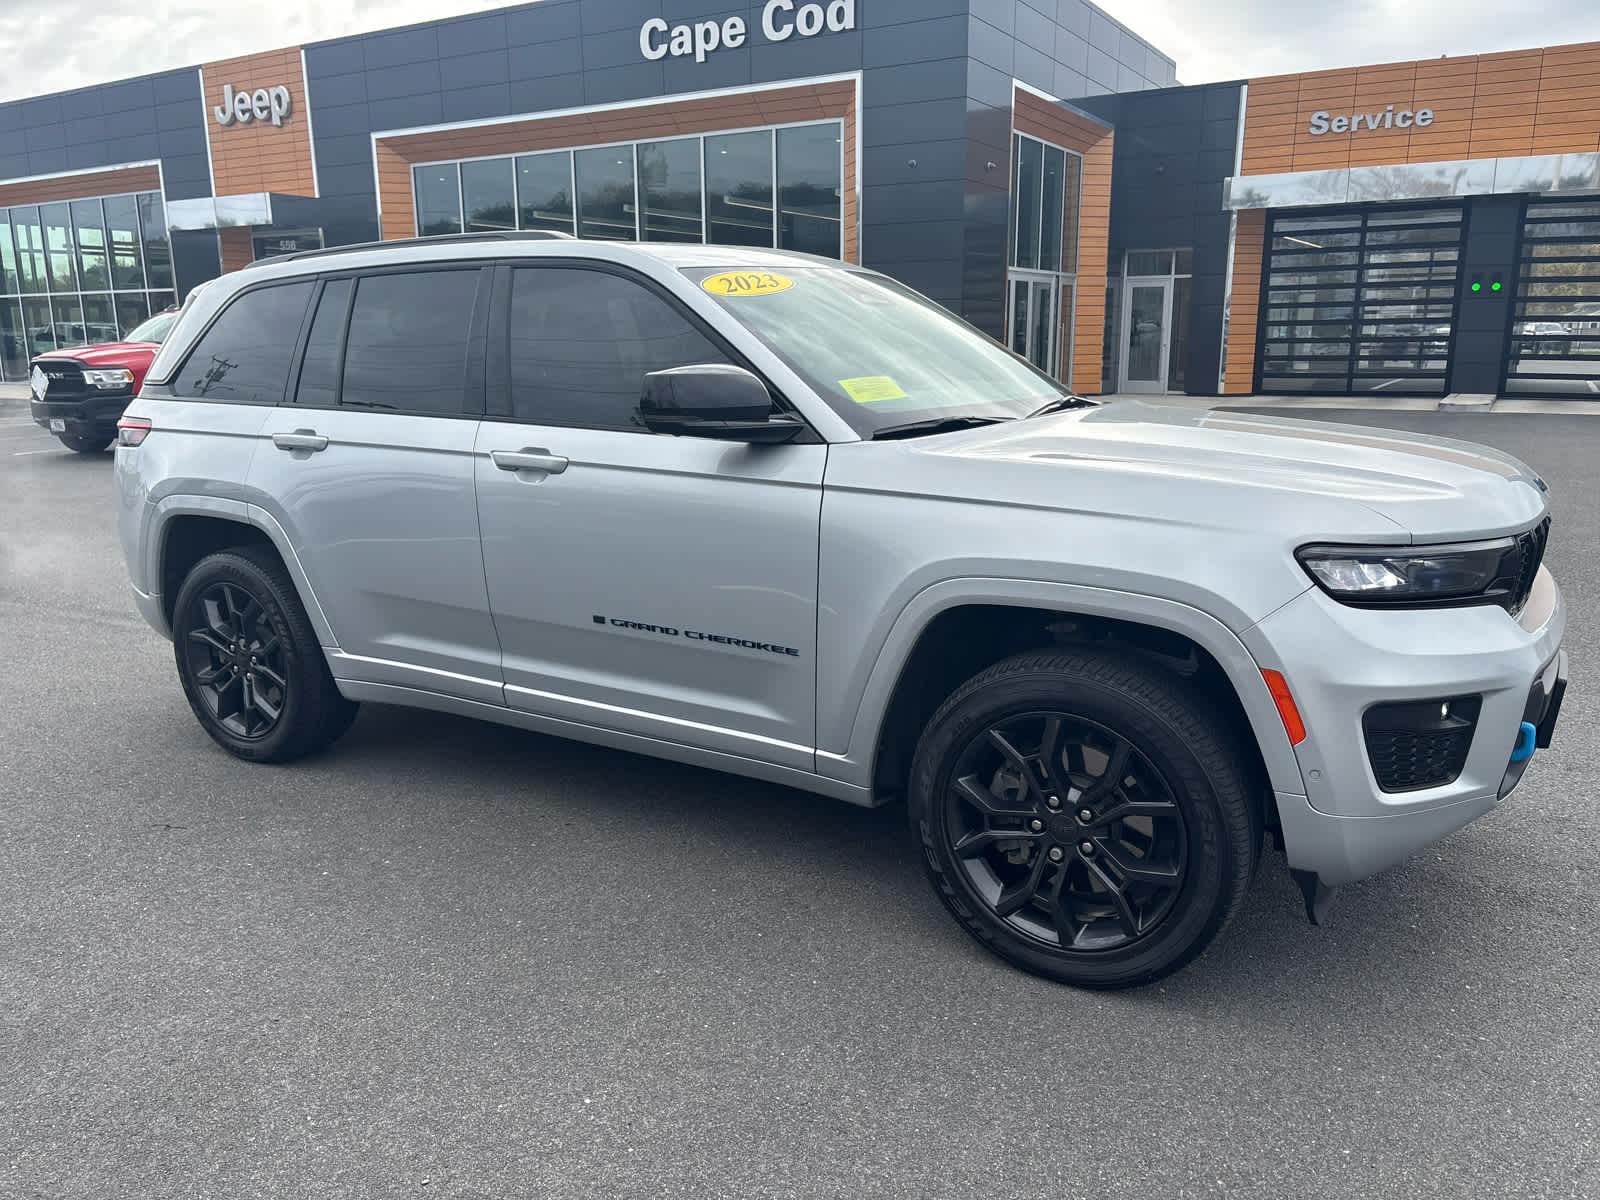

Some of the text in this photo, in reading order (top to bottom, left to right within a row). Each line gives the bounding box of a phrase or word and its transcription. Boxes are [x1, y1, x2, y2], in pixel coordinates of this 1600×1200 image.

[640, 0, 855, 63] Cape Cod
[213, 84, 290, 127] Jeep
[1309, 105, 1433, 135] Service
[719, 274, 780, 293] 2023
[610, 618, 800, 657] GRAND CHEROKEE
